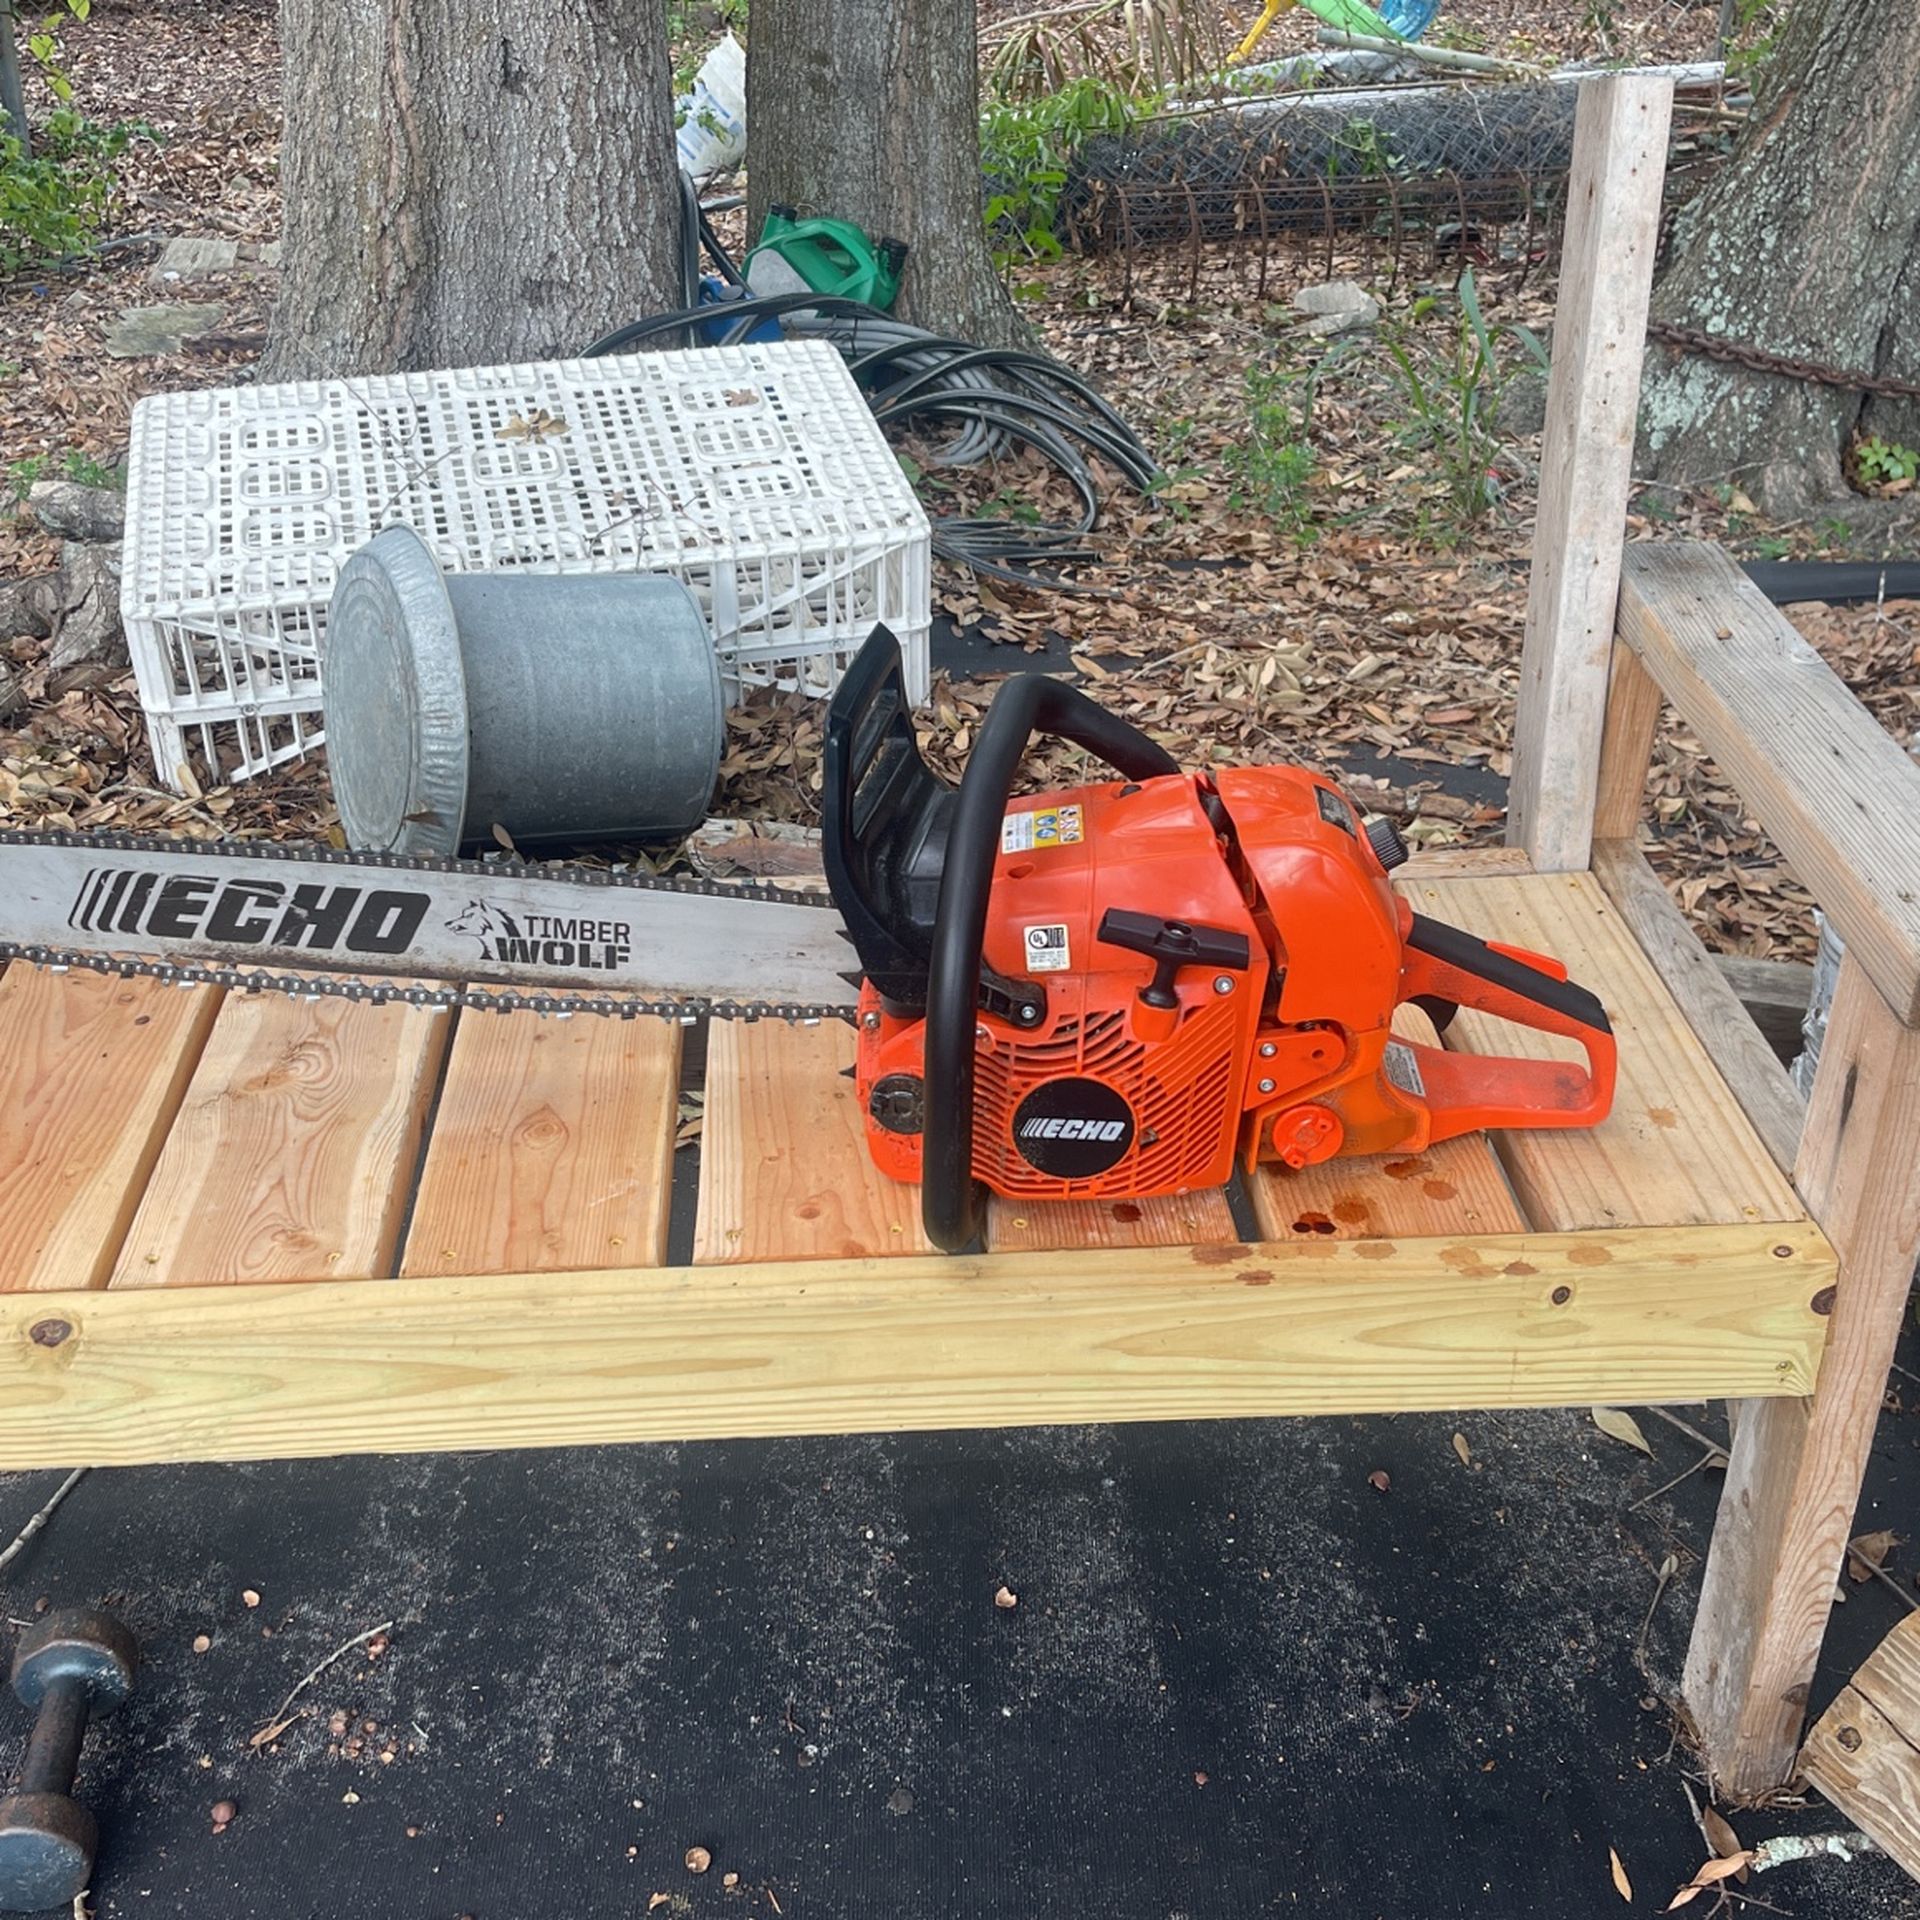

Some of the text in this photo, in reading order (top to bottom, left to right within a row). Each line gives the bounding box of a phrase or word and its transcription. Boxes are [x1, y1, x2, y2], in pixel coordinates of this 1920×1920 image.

[145, 874, 432, 954] ECHO
[523, 914, 631, 945] TIMBER
[495, 936, 631, 970] WOLF
[1042, 1117, 1126, 1142] ECHO
